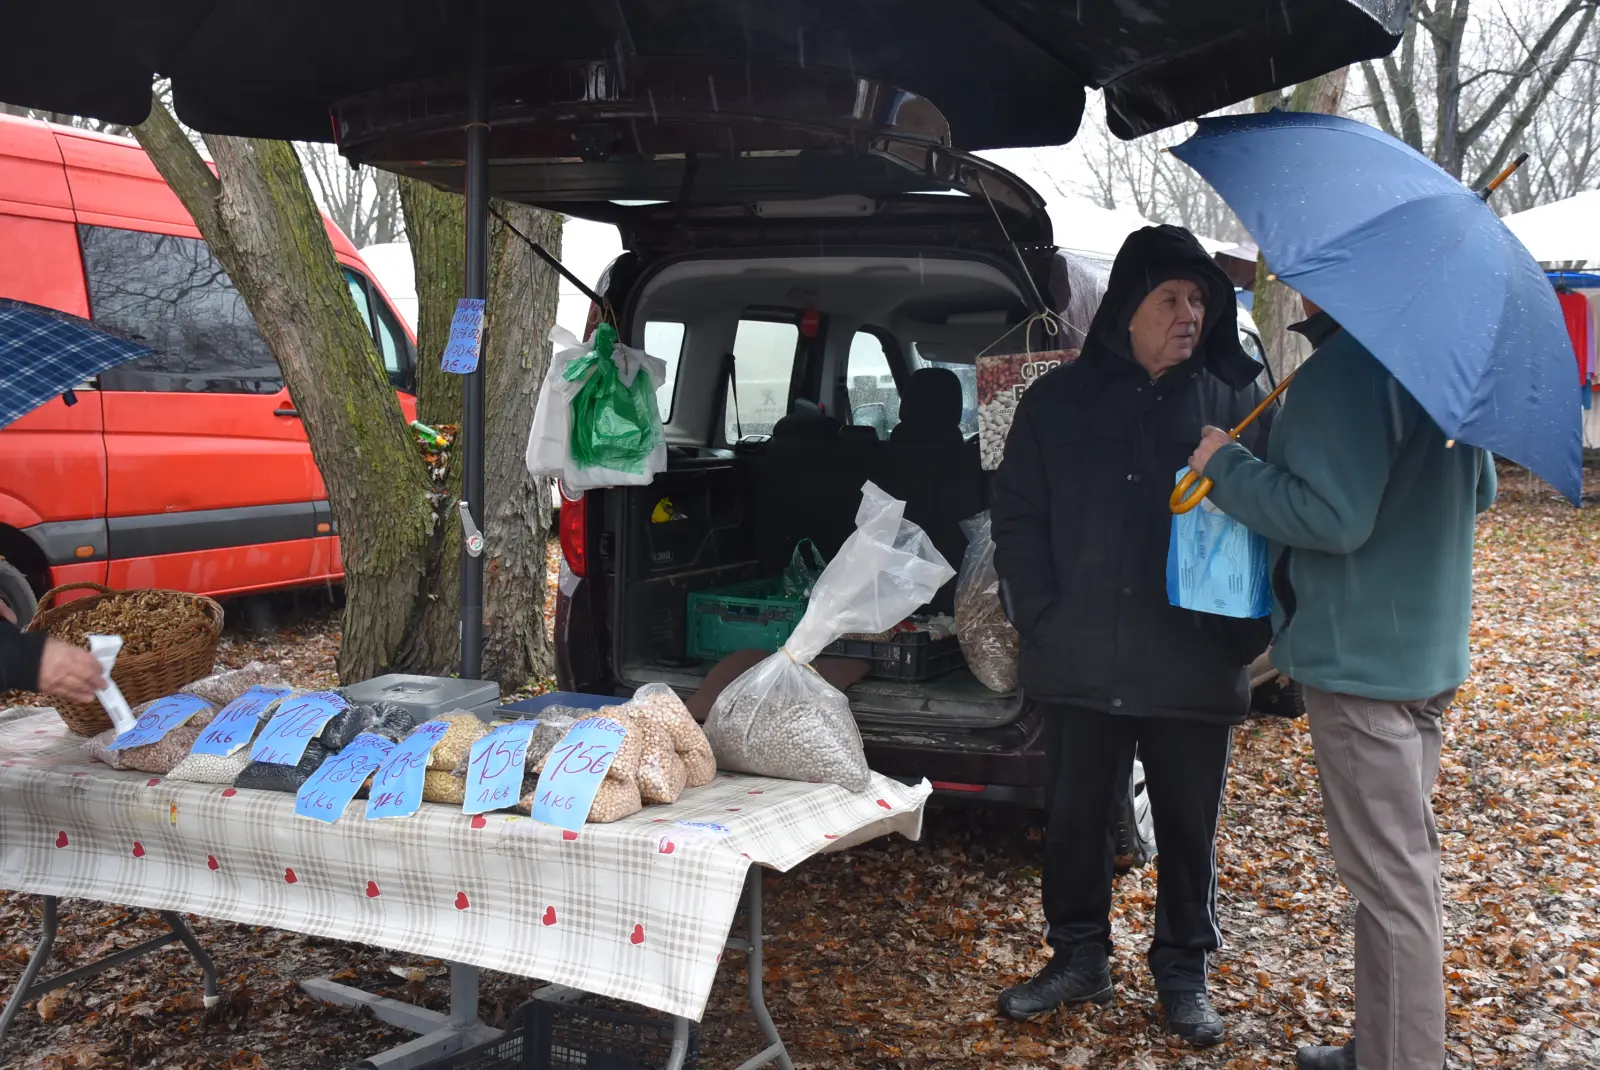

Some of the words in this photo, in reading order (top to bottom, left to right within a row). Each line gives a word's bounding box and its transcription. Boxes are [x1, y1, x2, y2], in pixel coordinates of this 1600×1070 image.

[266, 703, 330, 740] 10€
[472, 738, 529, 785] 15€
[549, 741, 615, 781] 15€
